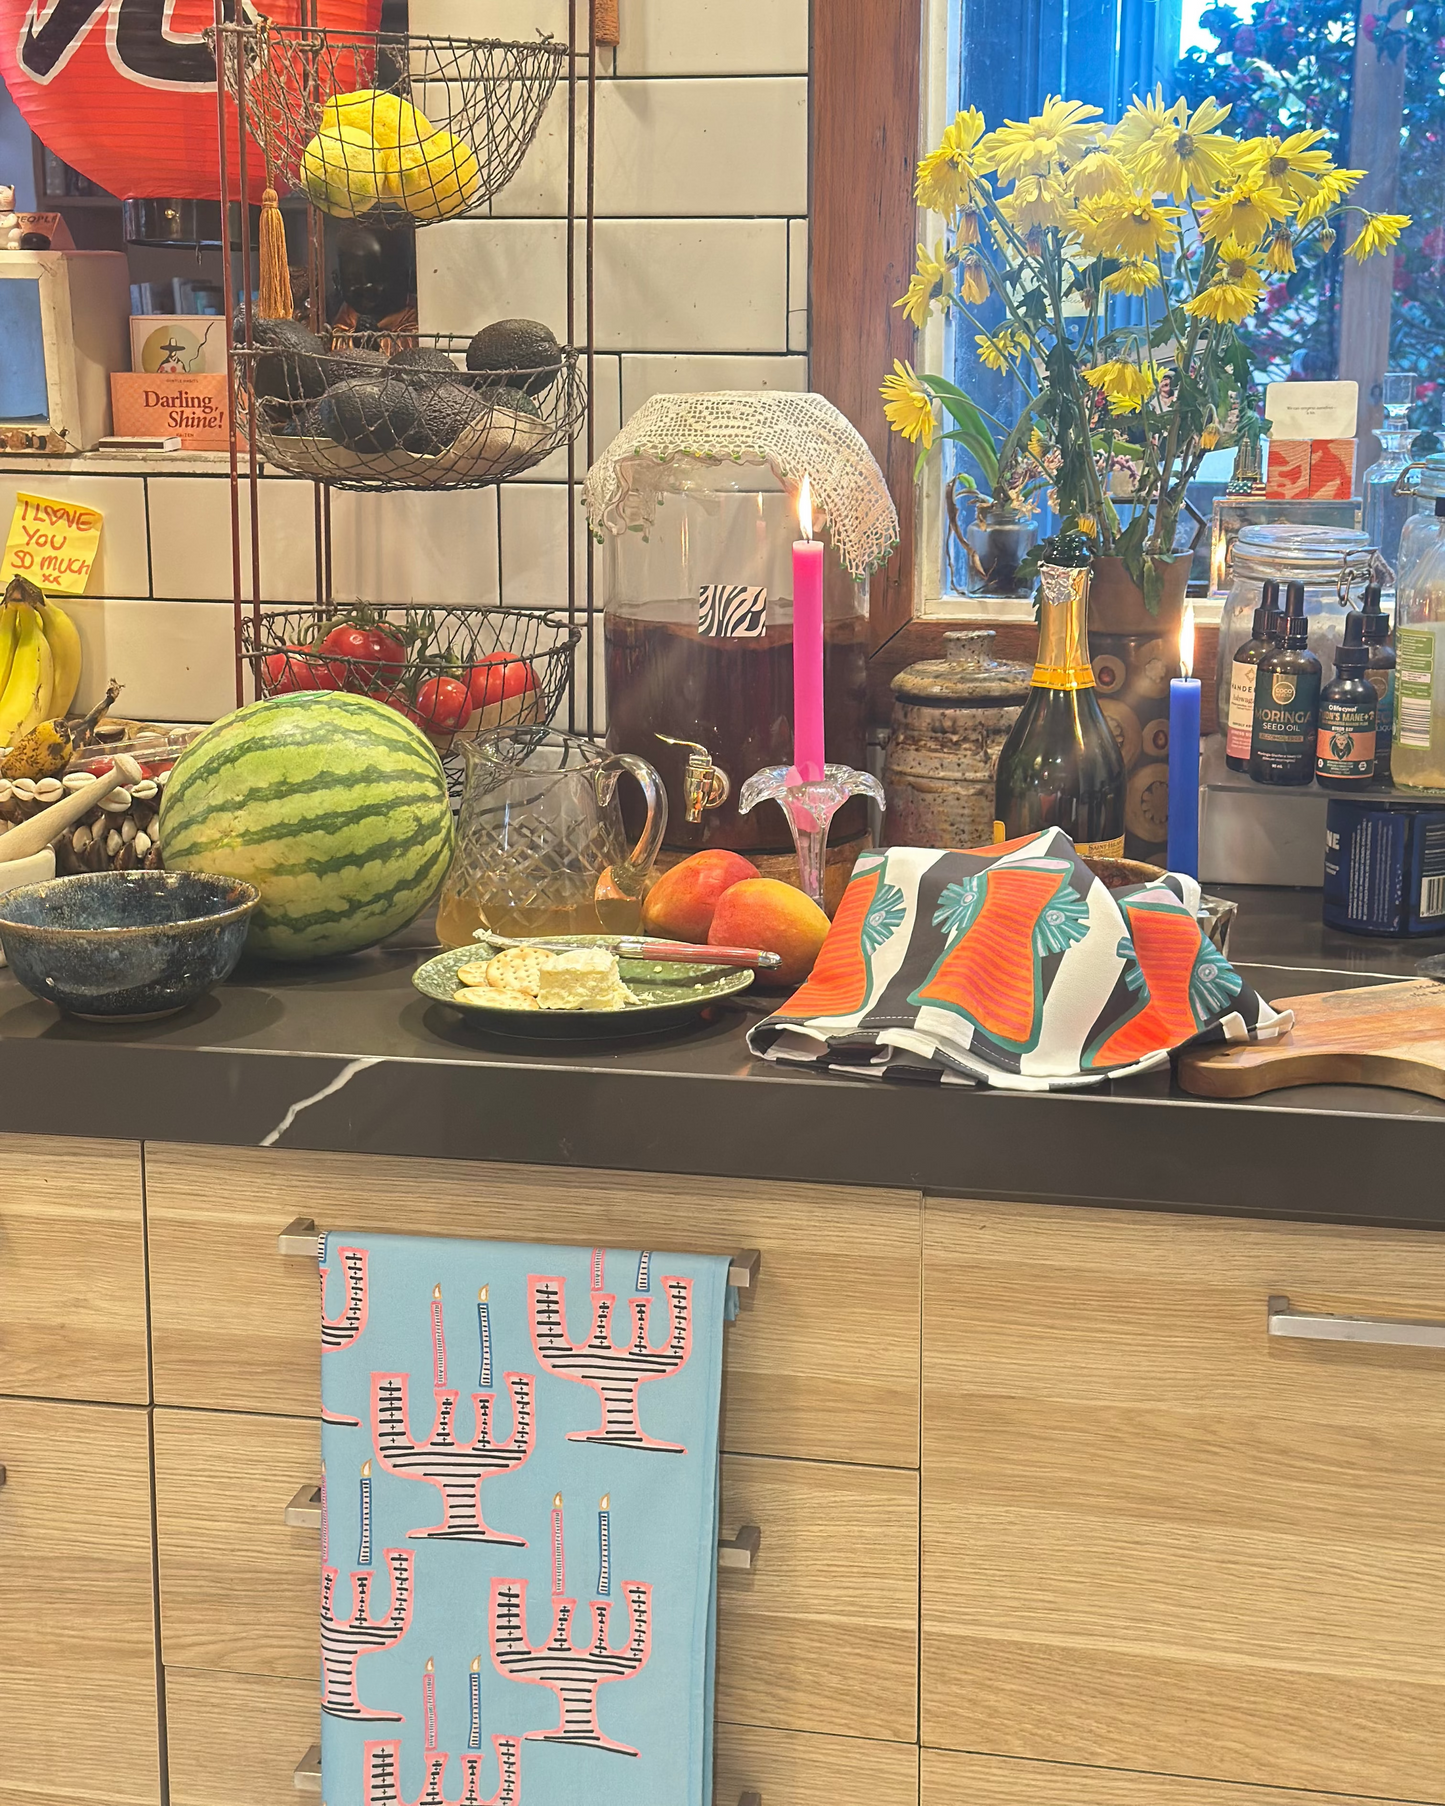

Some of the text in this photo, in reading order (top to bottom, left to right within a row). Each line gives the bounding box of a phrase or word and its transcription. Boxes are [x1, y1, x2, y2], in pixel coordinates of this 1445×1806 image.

[143, 390, 218, 414] Darling,
[167, 411, 224, 429] Shine!
[21, 500, 29, 521] I
[22, 525, 67, 551] YOU
[11, 549, 34, 570] SO
[1262, 721, 1285, 731] SEED
[1286, 723, 1301, 732] OIL
